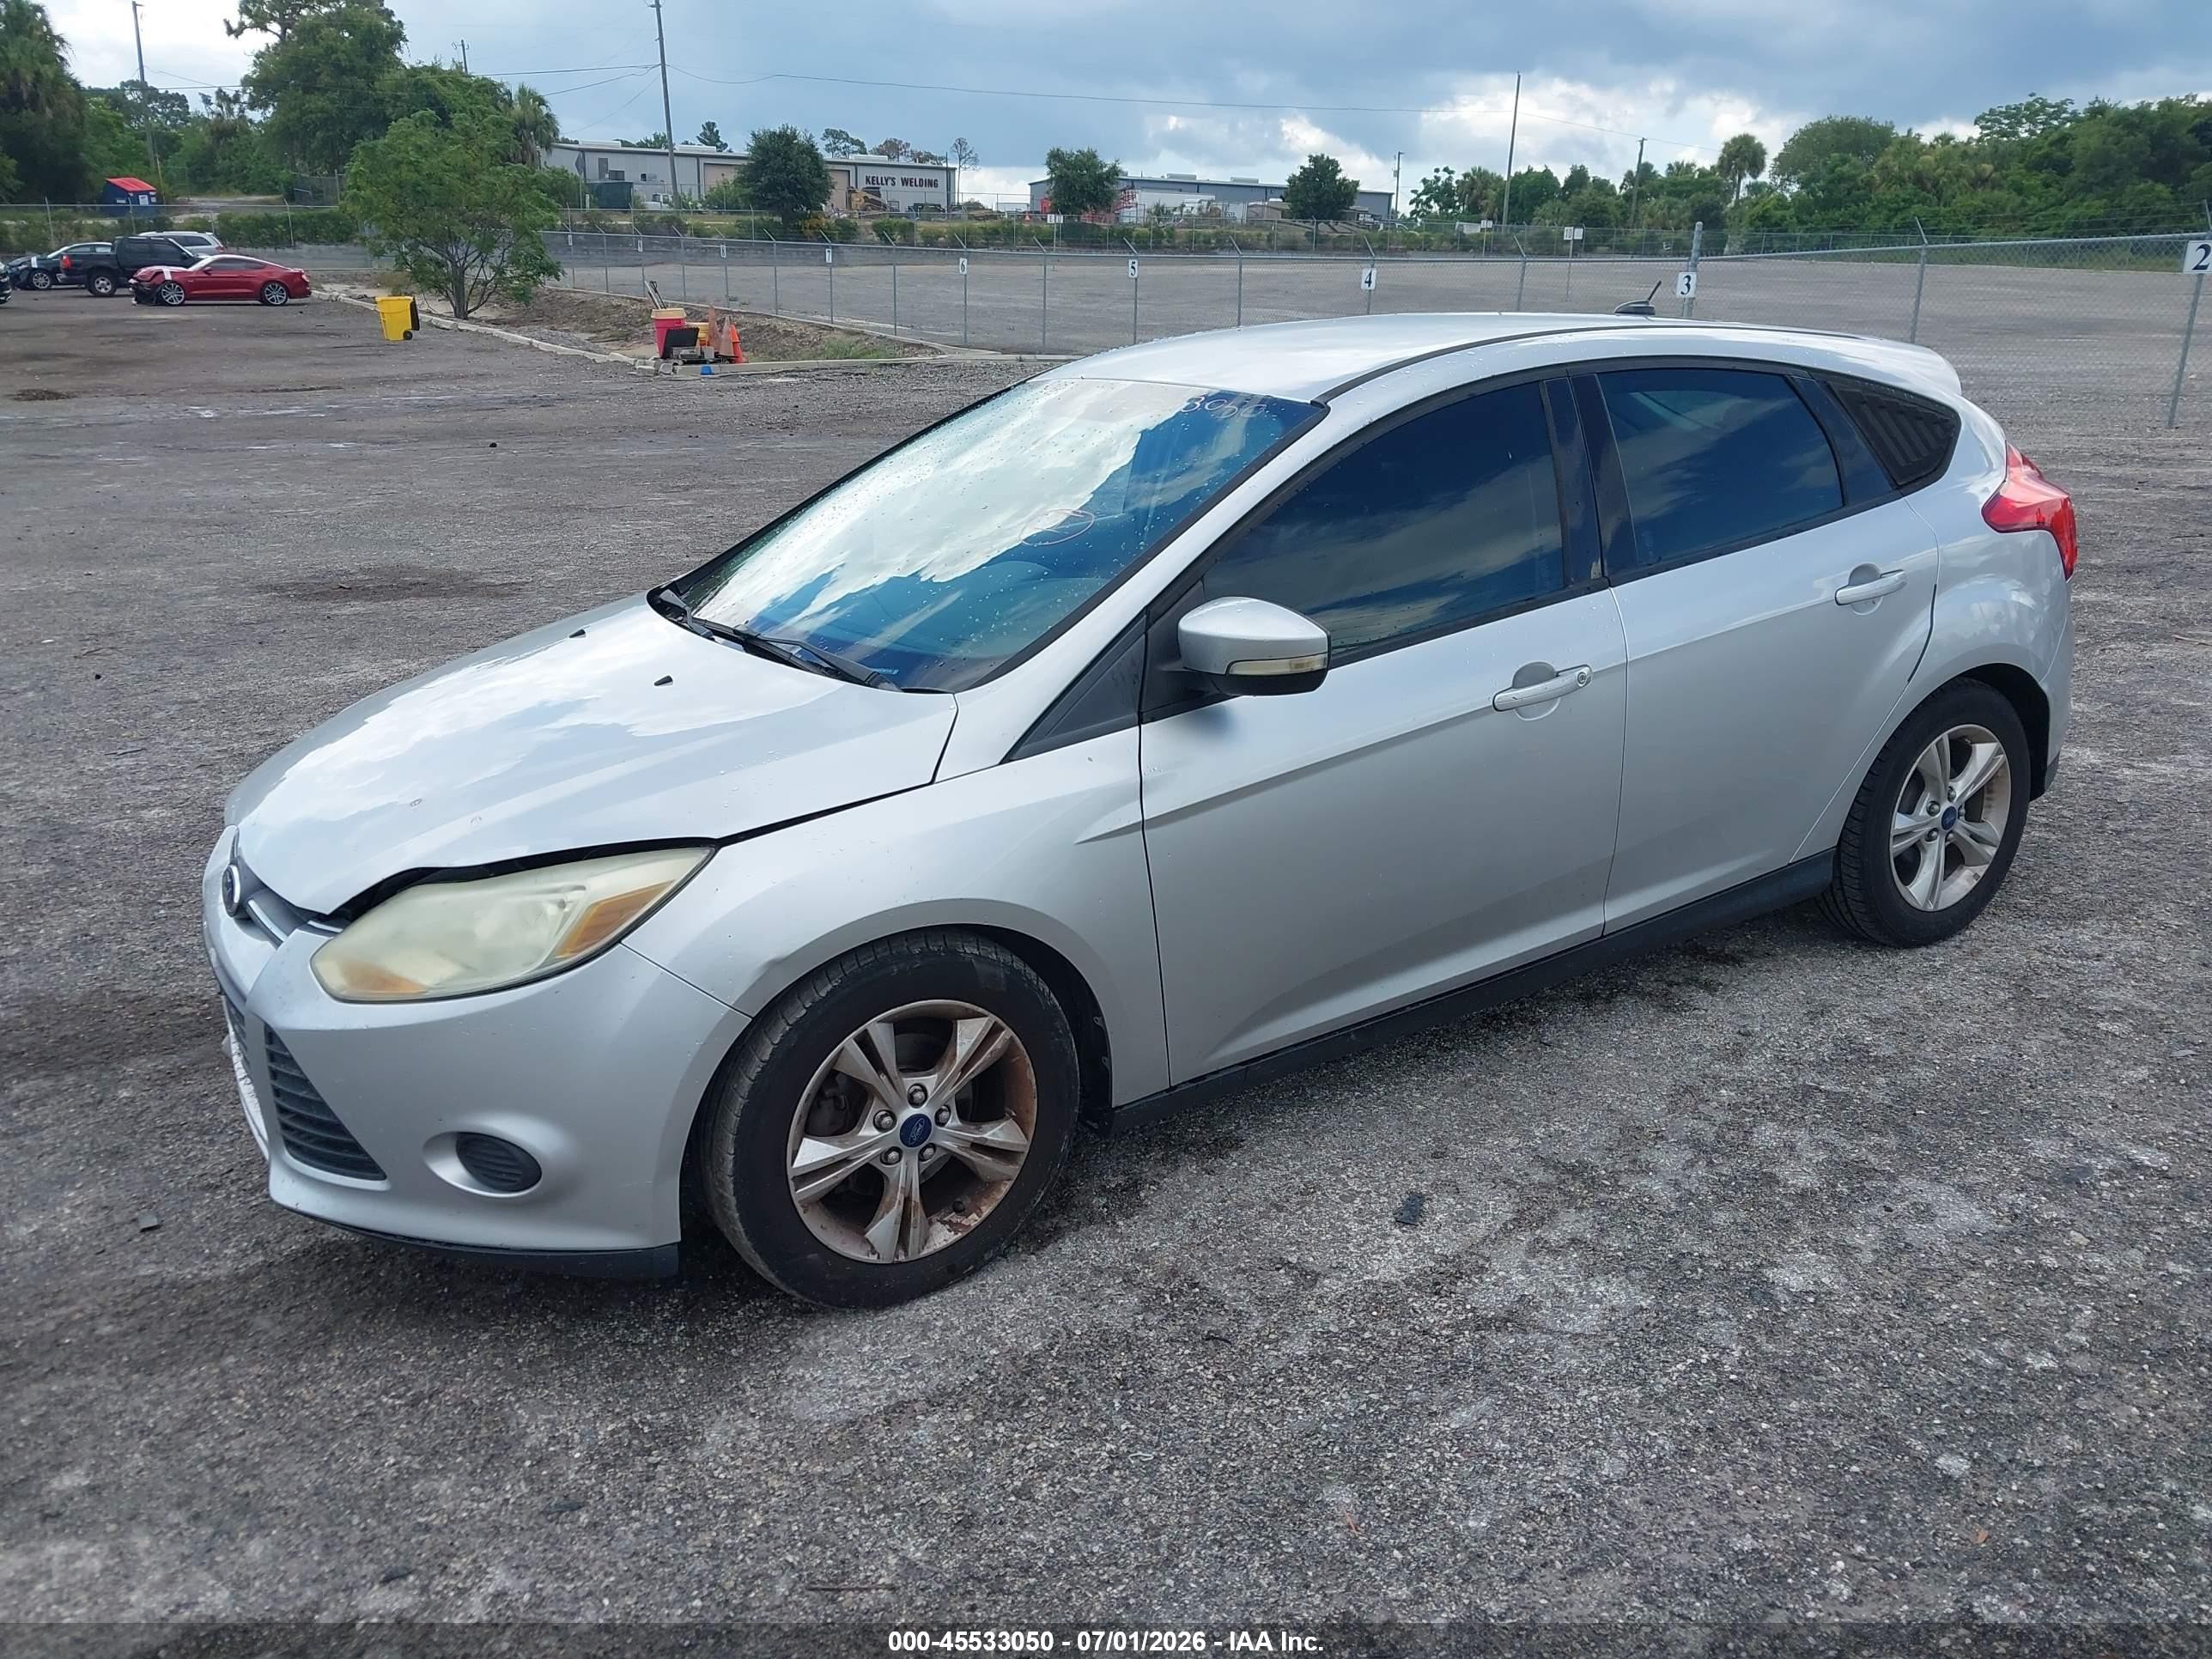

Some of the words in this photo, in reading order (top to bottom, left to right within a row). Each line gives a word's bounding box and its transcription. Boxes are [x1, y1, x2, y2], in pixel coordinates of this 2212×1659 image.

[865, 175, 896, 186] KELLY'S
[901, 177, 939, 188] WELDING
[2192, 243, 2212, 271] 2
[960, 259, 966, 273] 6
[1130, 261, 1136, 276] 5
[1364, 269, 1373, 288] 4
[1680, 275, 1692, 295] 3
